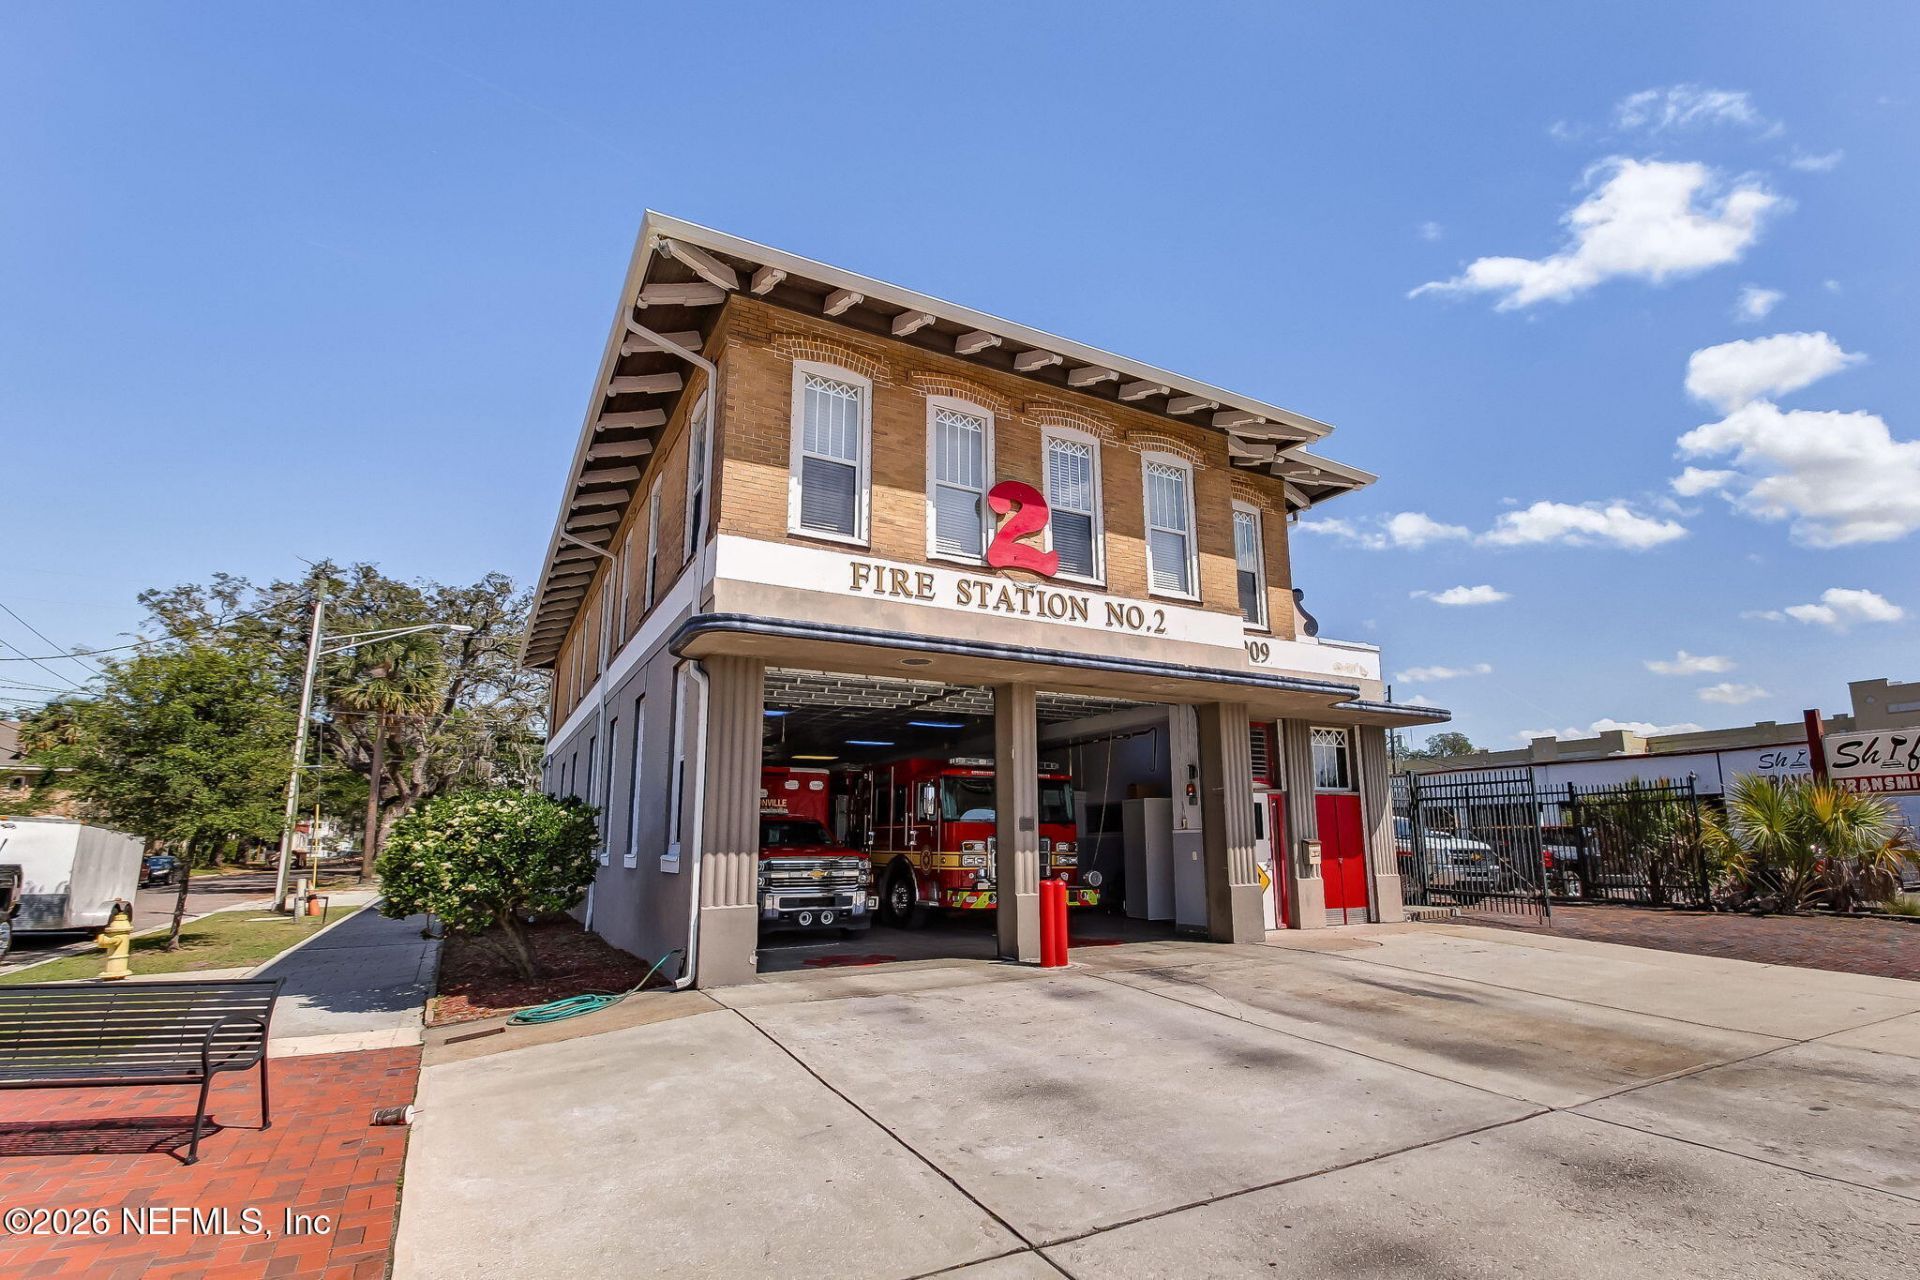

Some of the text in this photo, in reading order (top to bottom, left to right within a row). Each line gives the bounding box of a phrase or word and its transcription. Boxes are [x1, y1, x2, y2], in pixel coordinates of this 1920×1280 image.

[987, 480, 1060, 577] 2
[849, 561, 1168, 634] FIRE STATION NO.2
[760, 798, 788, 807] NVILLE
[1833, 775, 1920, 795] TRANSMI
